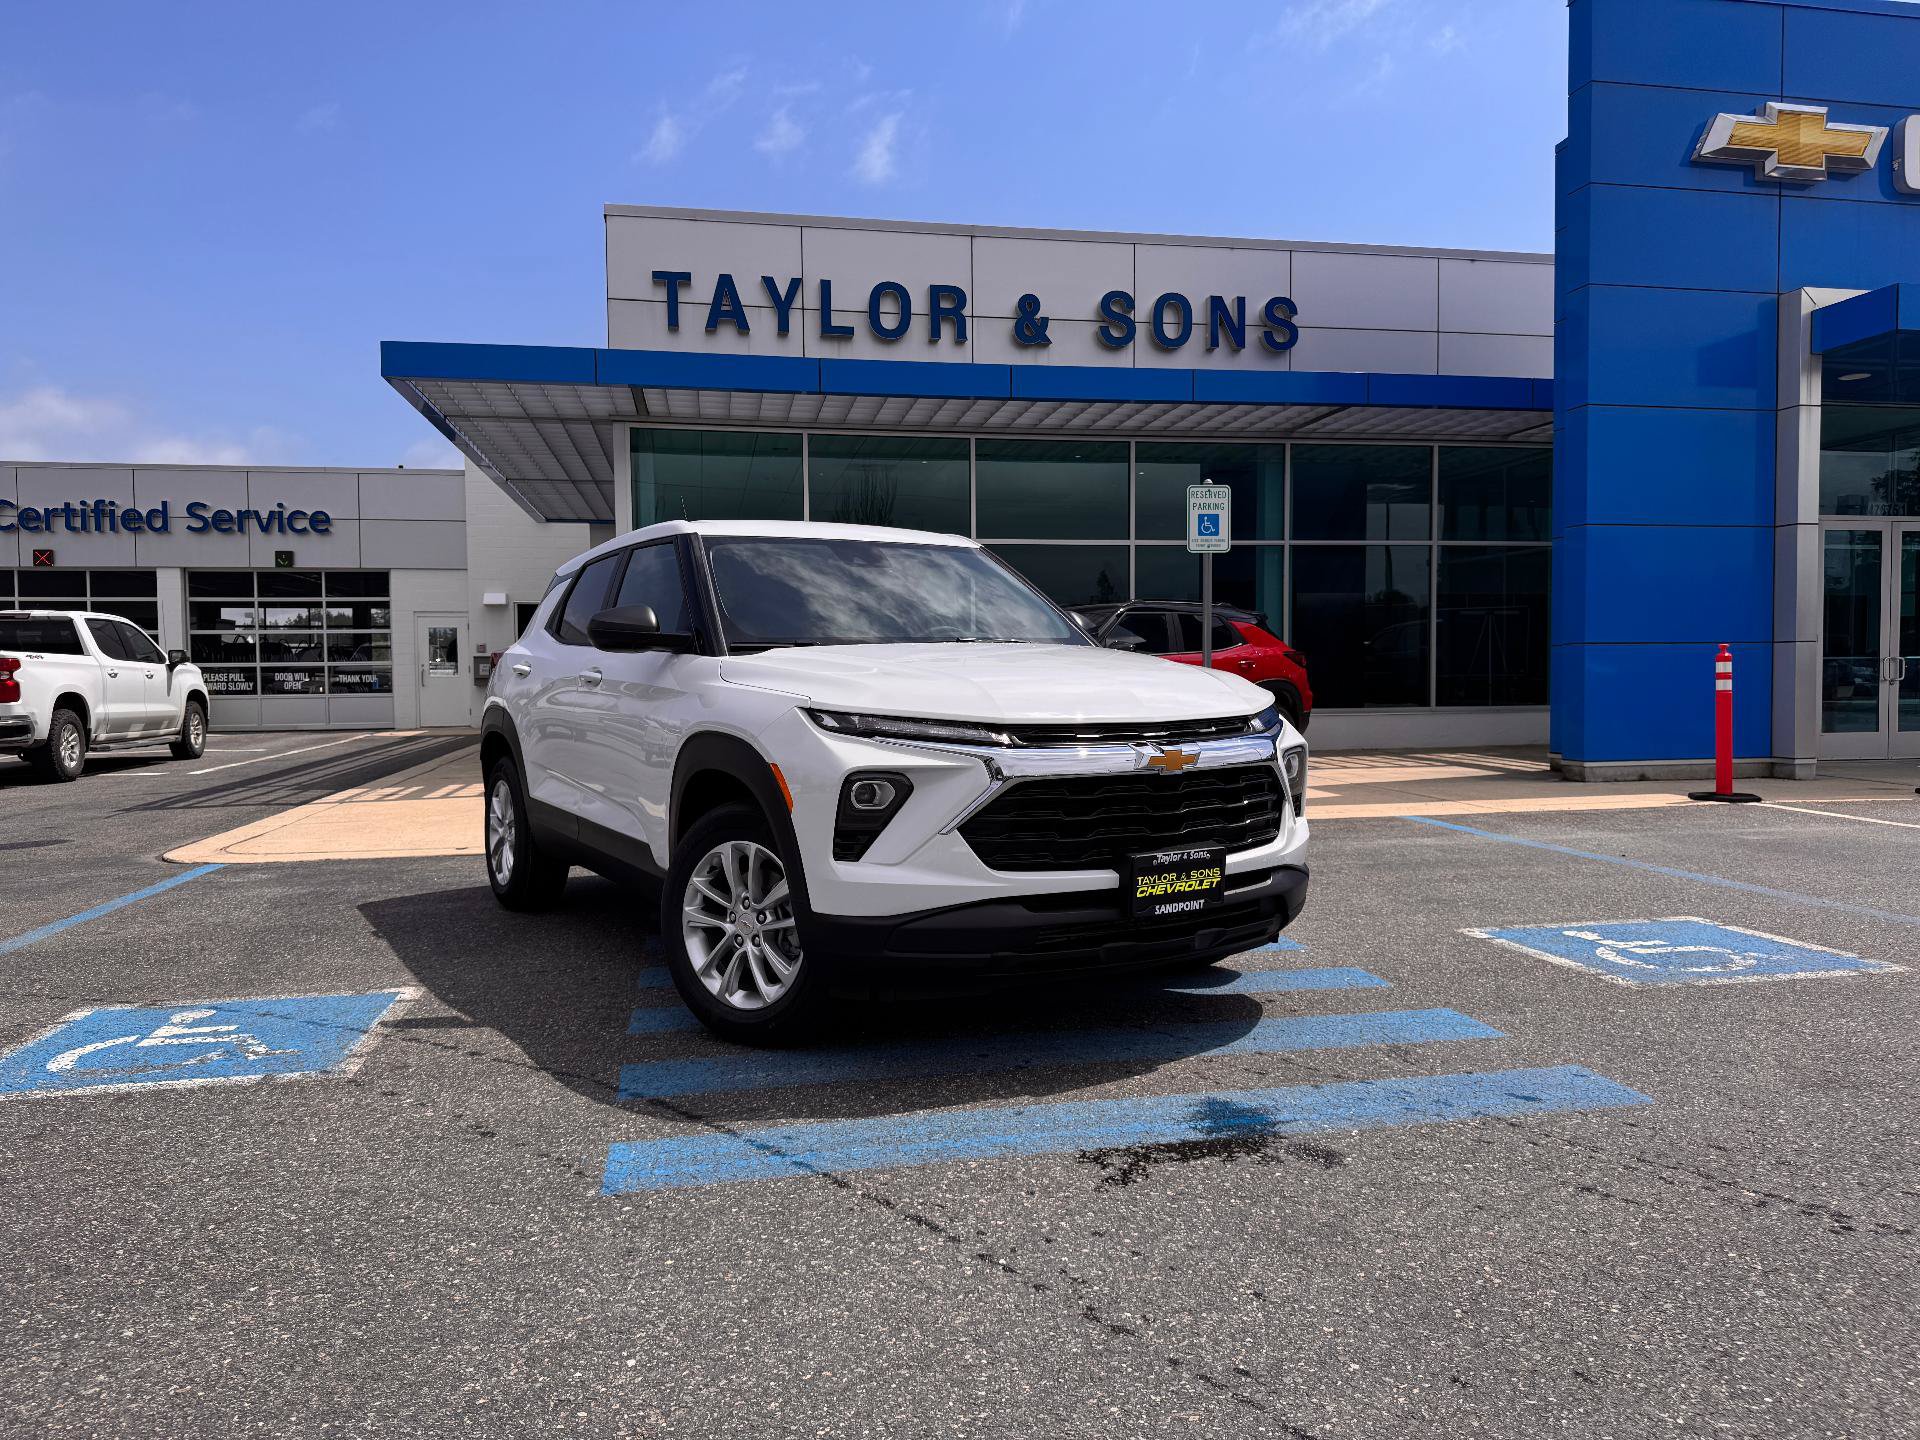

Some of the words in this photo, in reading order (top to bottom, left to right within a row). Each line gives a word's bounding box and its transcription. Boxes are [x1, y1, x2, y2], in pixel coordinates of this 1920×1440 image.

[651, 271, 968, 343] TAYLOR
[1013, 293, 1053, 346] &
[1097, 290, 1299, 352] SONS
[1191, 490, 1227, 499] RESERVED
[1192, 502, 1225, 511] PARKING
[0, 498, 169, 533] Certified
[185, 501, 331, 534] Service
[203, 673, 228, 682] PLEASE
[229, 673, 246, 682] PULL
[275, 672, 294, 681] DOOR
[294, 672, 309, 682] WILL
[339, 674, 361, 684] THANK
[228, 681, 254, 691] SLOWLY
[284, 681, 302, 690] OPEN
[1157, 853, 1181, 864] Taylor
[1189, 851, 1208, 860] Sons
[1137, 873, 1177, 886] TAYLOR
[1180, 872, 1187, 881] &
[1190, 867, 1221, 880] SONS
[1137, 878, 1221, 897] CHEVROLET
[1154, 899, 1205, 915] SANDPOINT
